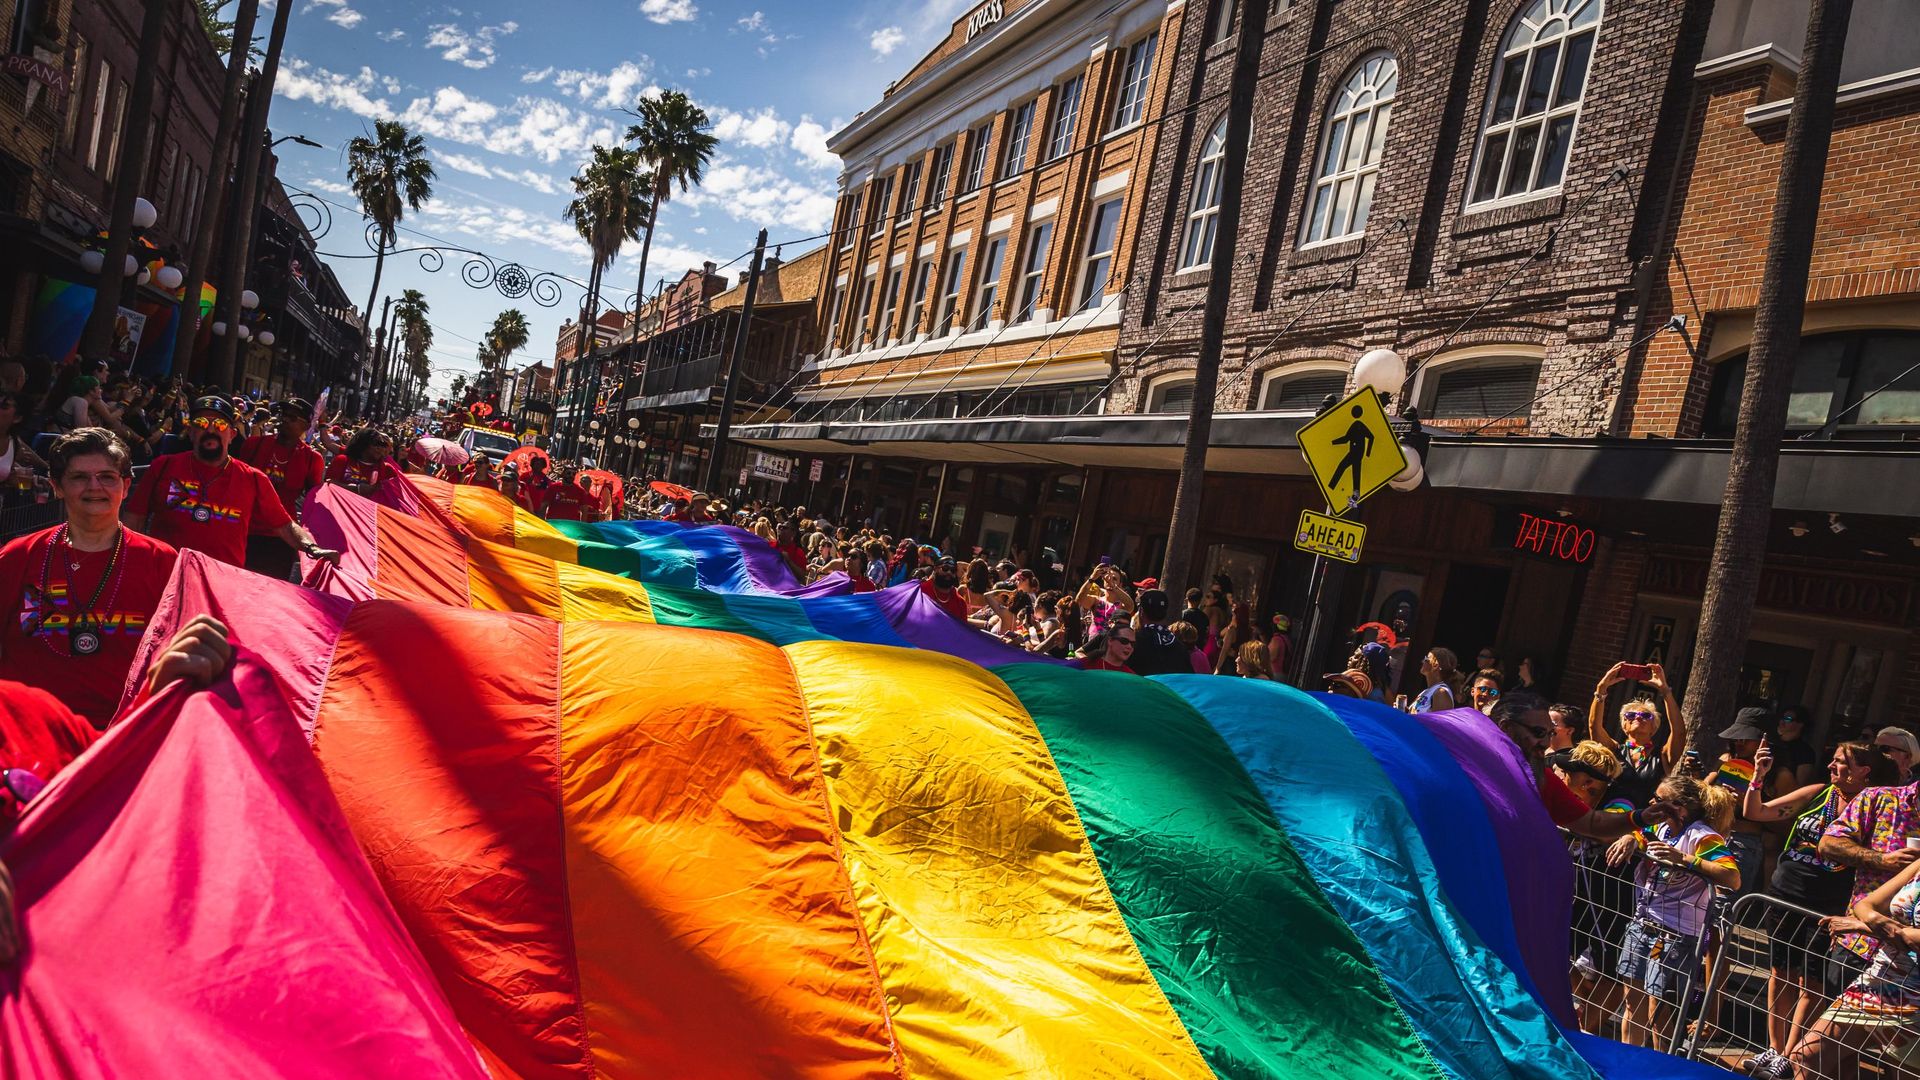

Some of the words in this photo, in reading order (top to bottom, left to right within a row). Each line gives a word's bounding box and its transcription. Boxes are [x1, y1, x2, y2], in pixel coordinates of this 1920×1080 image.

[964, 0, 1003, 44] KRESS
[8, 56, 64, 91] PRANA
[1307, 523, 1356, 550] AHEAD
[1515, 513, 1595, 563] TATTOO
[1764, 573, 1898, 617] TATTOOS
